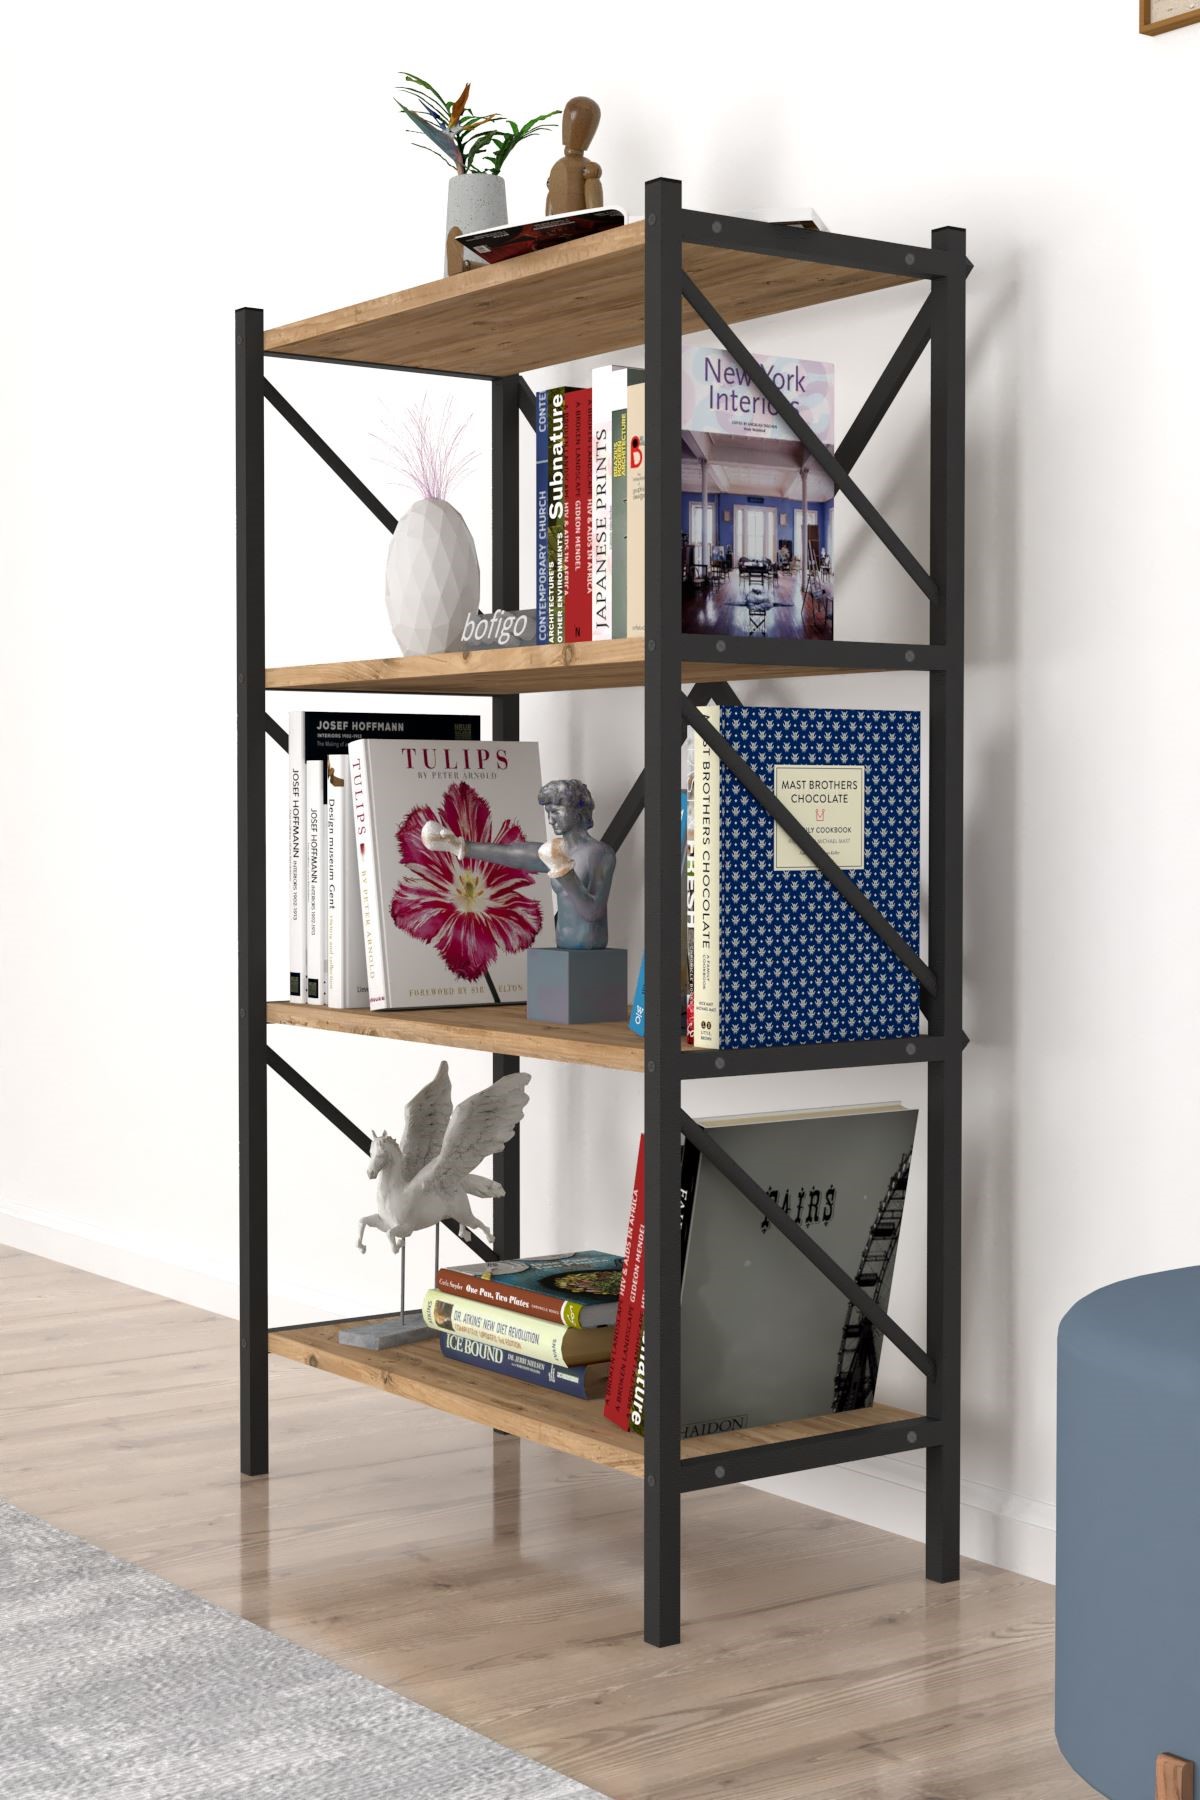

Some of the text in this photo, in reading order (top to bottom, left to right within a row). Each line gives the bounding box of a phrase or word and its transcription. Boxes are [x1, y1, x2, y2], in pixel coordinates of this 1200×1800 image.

[704, 357, 752, 387] New
[709, 385, 800, 416] Interios
[549, 394, 564, 519] Subnature
[538, 490, 546, 540] CHURCH
[596, 428, 608, 628] JAPANESE PRINTS
[538, 544, 546, 641] CONTEMPORARY
[460, 609, 528, 646] bofigo
[316, 720, 404, 732] JOSEF HOFFMANN
[402, 748, 509, 770] TULIPS
[292, 768, 300, 797] JOSEF
[463, 772, 497, 780] ARNOLD
[781, 780, 858, 790] MAST BROTHERS
[702, 761, 710, 846] BROTHERS
[790, 794, 848, 804] CHOCOLATE
[292, 800, 300, 858] HOFFMANN
[310, 808, 318, 832] JOSEF
[816, 826, 852, 834] COOKBOOK
[310, 834, 318, 884] HOFFMANN
[352, 758, 366, 836] TULIPS
[366, 932, 375, 980] ARNOLD
[702, 850, 710, 948] CHOCOLATE
[630, 1190, 638, 1226] AFRICA
[627, 1227, 633, 1240] IN
[624, 1242, 632, 1266] AIDS
[622, 1268, 628, 1276] &
[630, 1264, 640, 1303] GIDEON
[466, 1284, 478, 1294] One
[480, 1288, 494, 1299] Pan,
[495, 1292, 508, 1303] Two
[508, 1296, 530, 1308] Plates
[483, 1318, 496, 1332] NEW
[496, 1323, 507, 1336] DIET
[508, 1325, 540, 1344] REVOLUTION
[445, 1333, 464, 1352] ICE
[464, 1339, 504, 1364] BOUND
[680, 1416, 744, 1438] HAIDON
